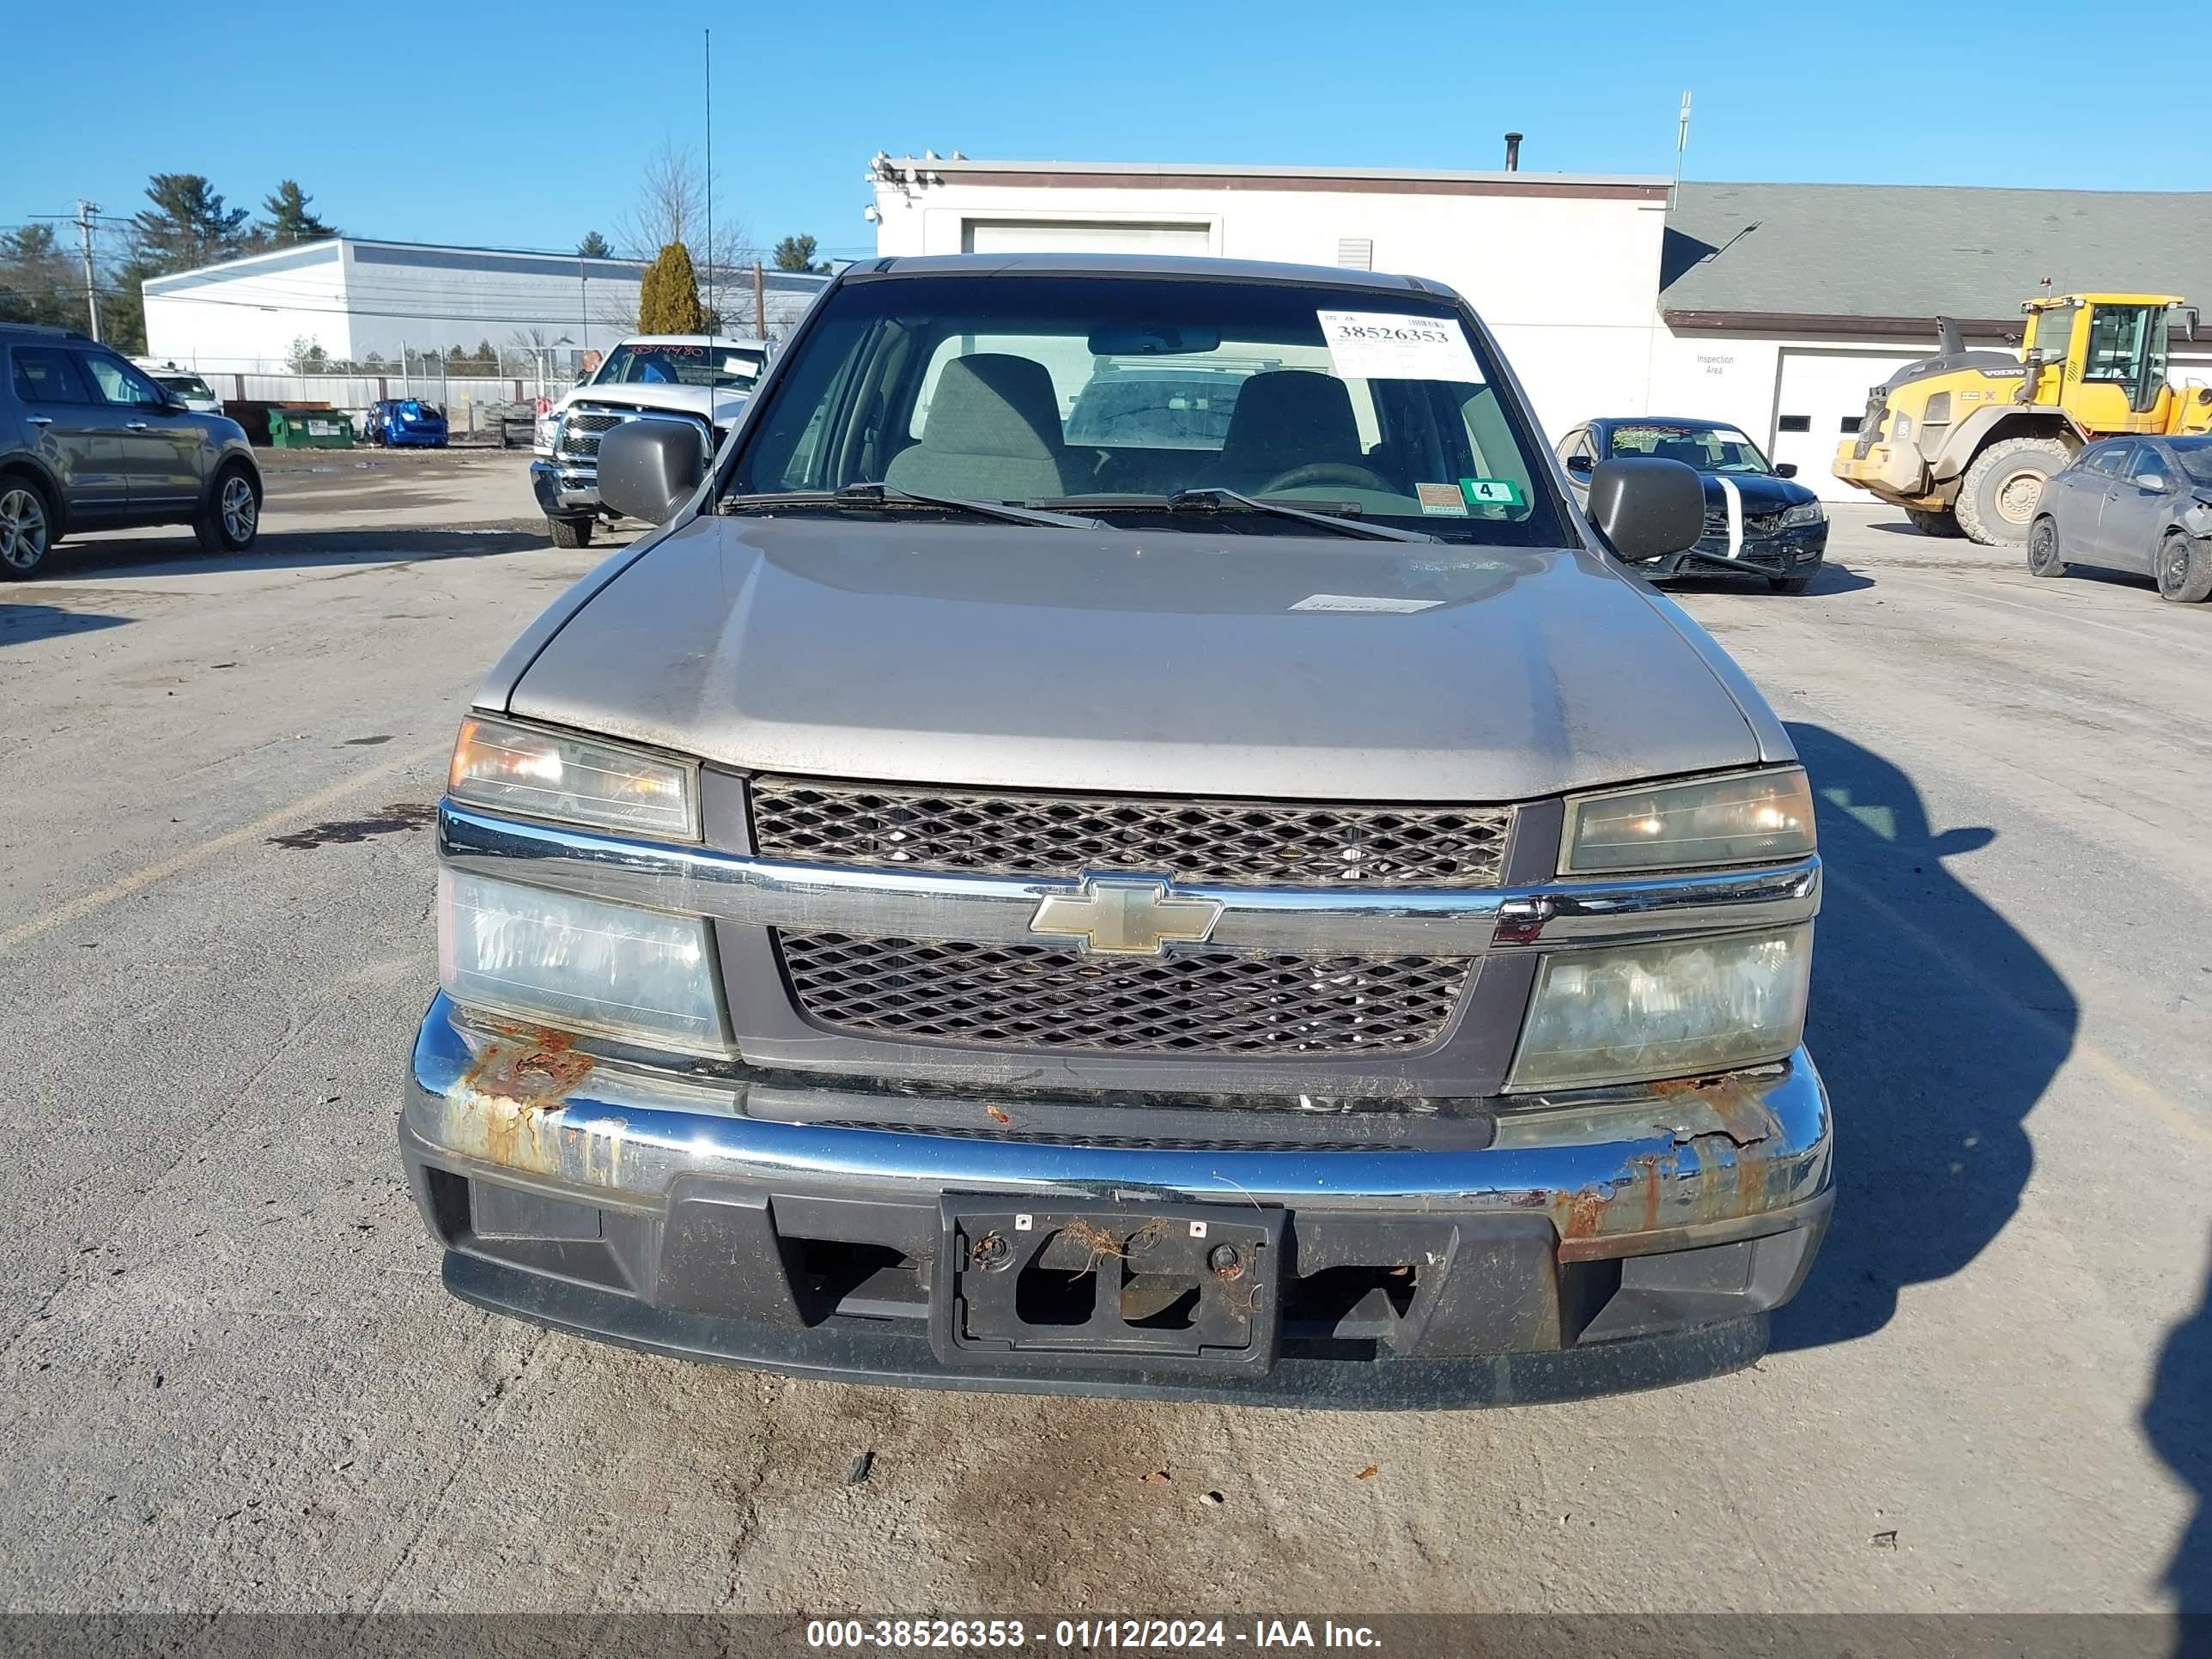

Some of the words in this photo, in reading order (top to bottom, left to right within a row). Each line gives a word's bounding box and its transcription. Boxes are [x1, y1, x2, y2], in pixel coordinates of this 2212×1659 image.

[1338, 325, 1449, 343] 38526353
[1697, 354, 1734, 364] Inspection
[1706, 365, 1723, 374] Area
[1897, 420, 1911, 439] L90H
[1480, 483, 1493, 497] 4
